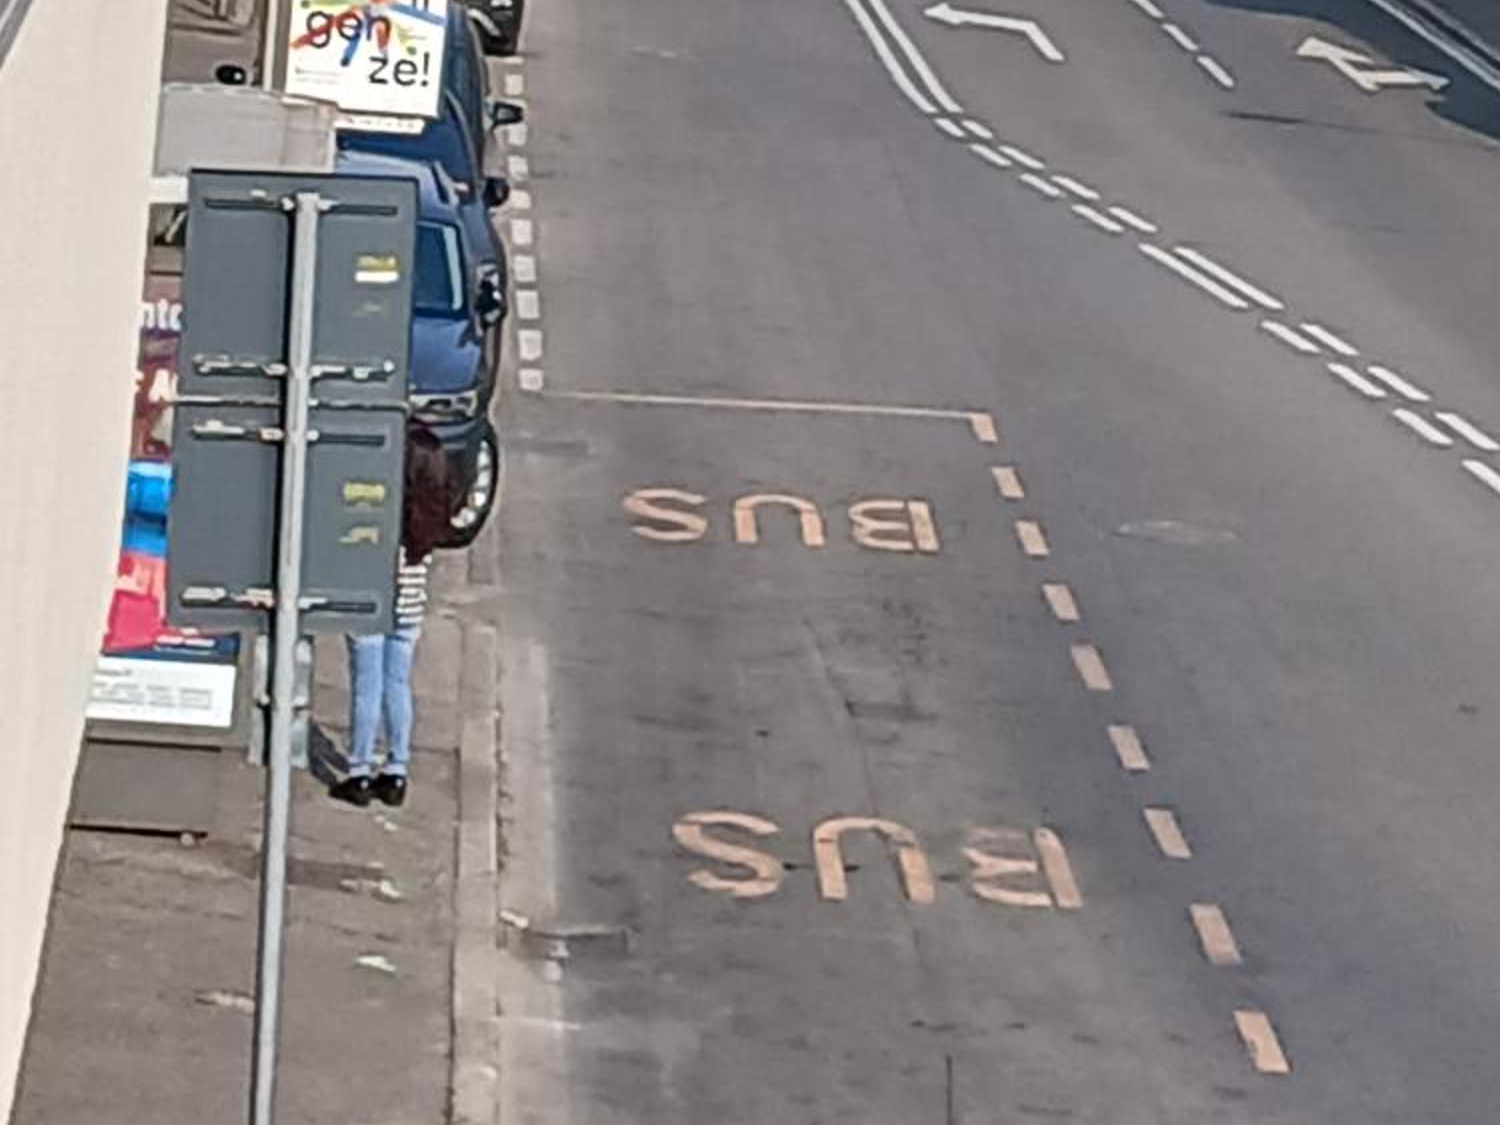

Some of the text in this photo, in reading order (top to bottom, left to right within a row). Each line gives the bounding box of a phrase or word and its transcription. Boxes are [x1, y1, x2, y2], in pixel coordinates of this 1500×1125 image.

[306, 9, 392, 50] gen
[368, 51, 431, 87] ze!
[621, 487, 939, 553] BUS
[672, 810, 1084, 908] BUS
